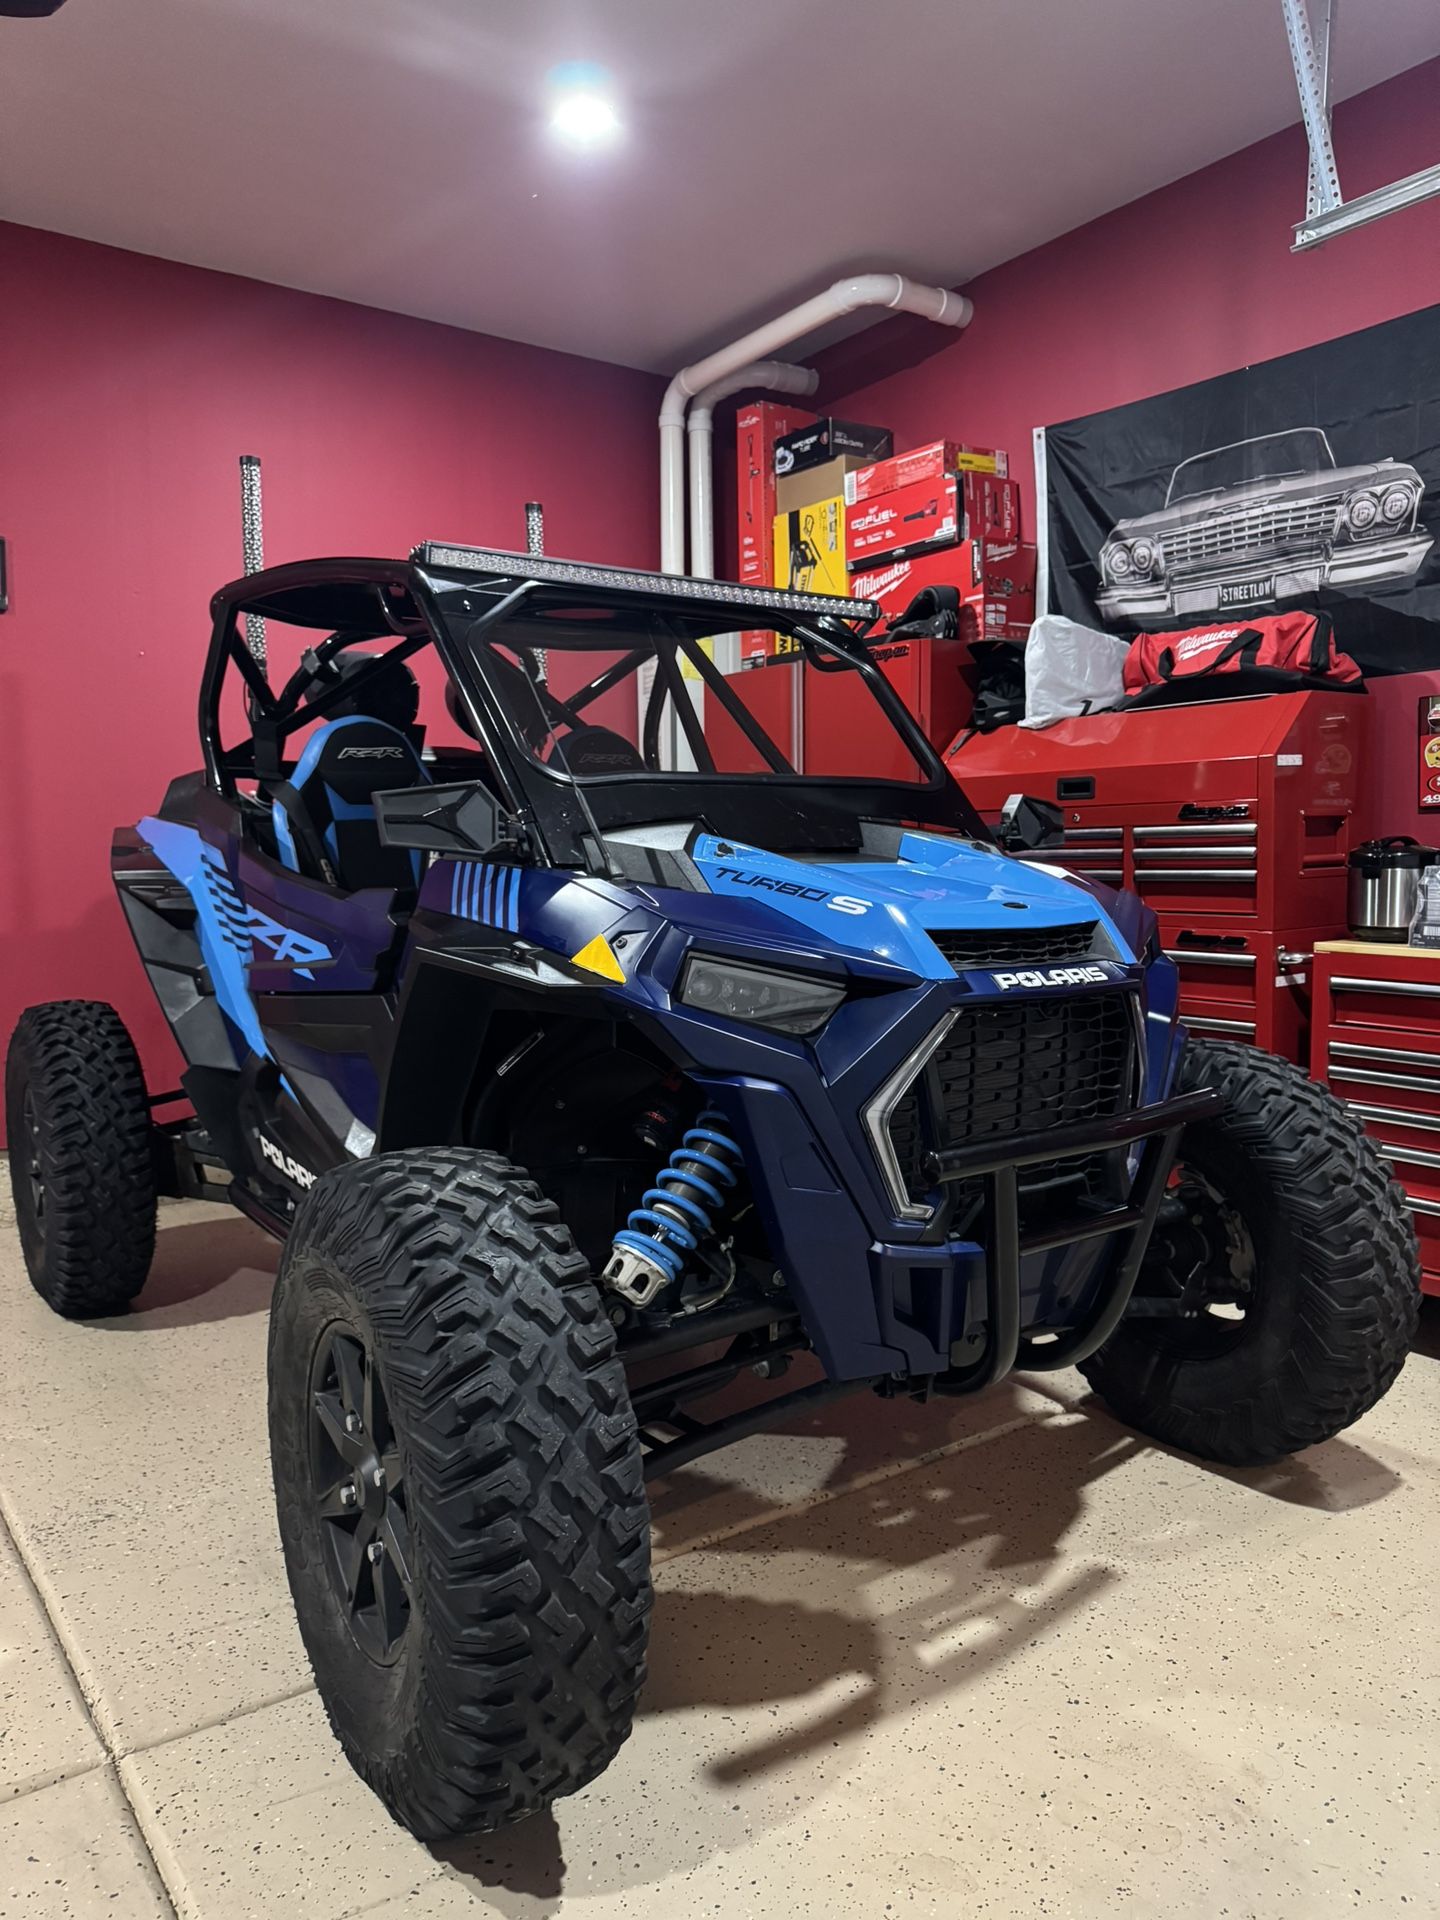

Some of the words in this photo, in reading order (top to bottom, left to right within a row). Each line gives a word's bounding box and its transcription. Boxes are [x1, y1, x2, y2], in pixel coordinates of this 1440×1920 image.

[865, 508, 898, 527] FUEL
[851, 560, 912, 599] Milwaukee
[1222, 582, 1272, 602] STREETLOW
[1176, 629, 1241, 651] Milwaukee
[337, 746, 405, 759] RZR
[716, 867, 831, 902] TURBO
[826, 895, 874, 915] S
[992, 966, 1109, 990] POLARIS
